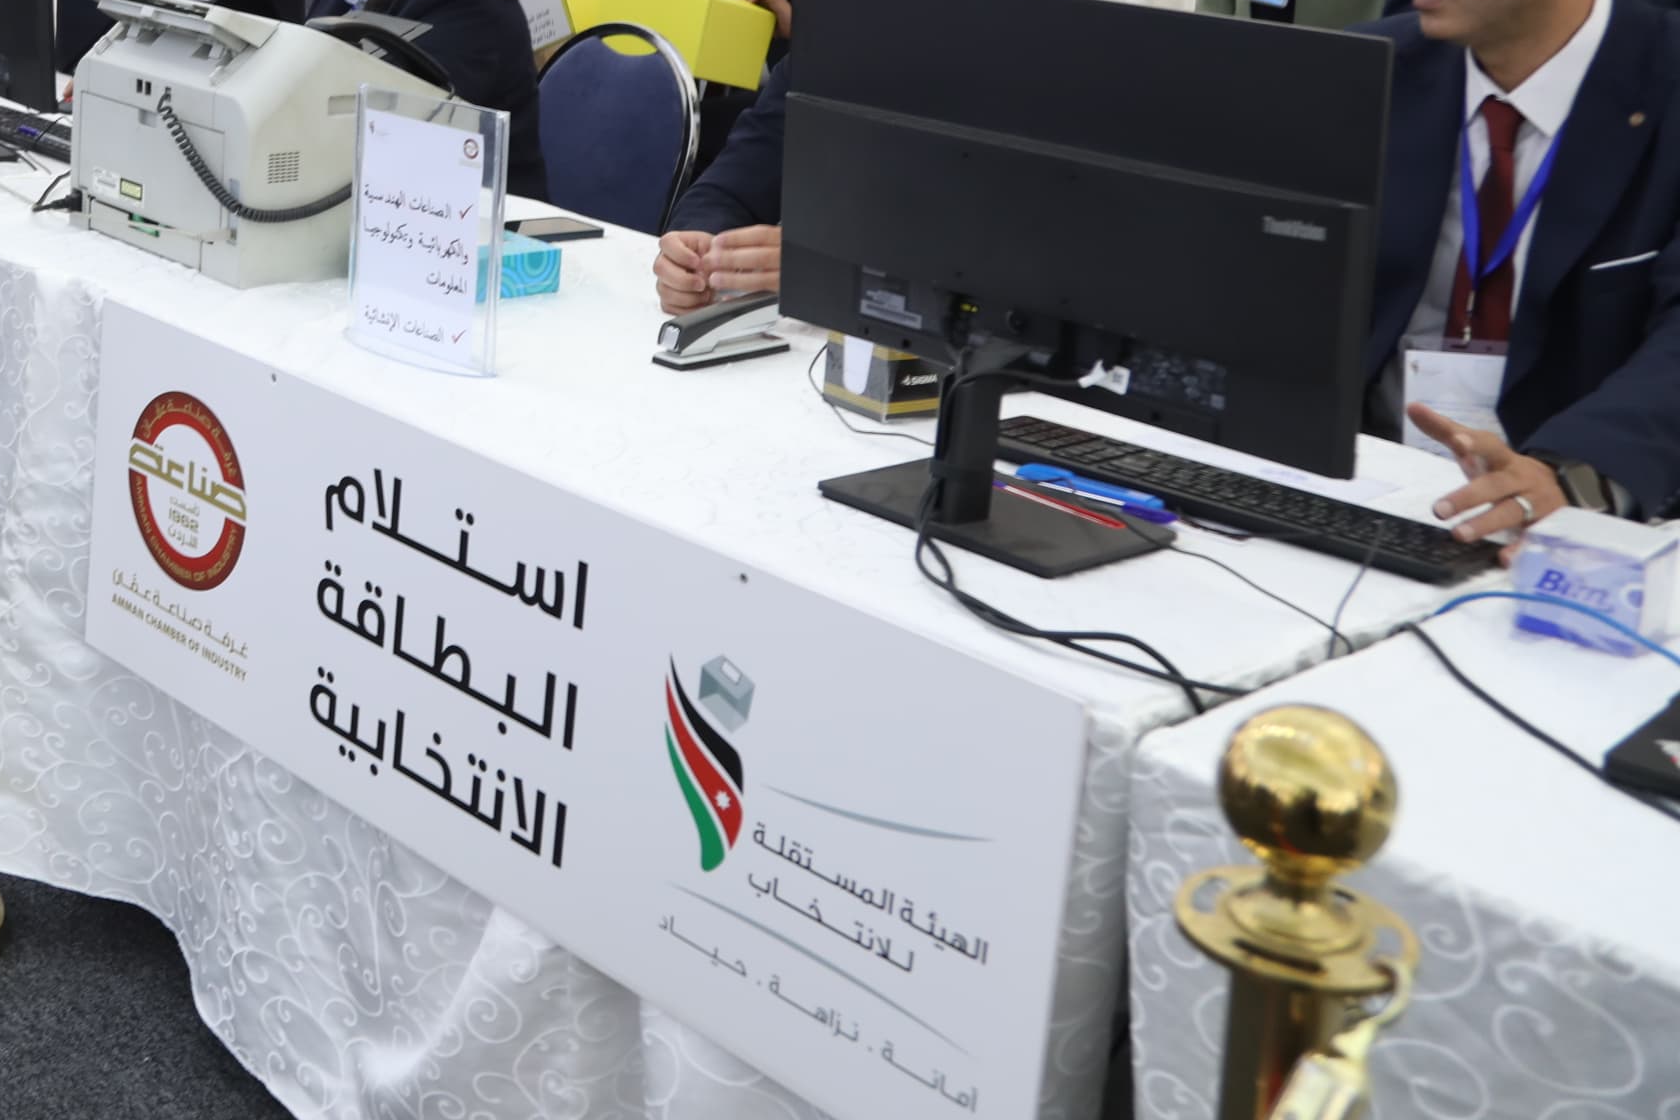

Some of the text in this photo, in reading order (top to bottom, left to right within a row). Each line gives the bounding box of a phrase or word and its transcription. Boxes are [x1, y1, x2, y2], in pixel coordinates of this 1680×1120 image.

[409, 196, 451, 219] الصناعات
[426, 270, 468, 295] المعلومات
[403, 320, 444, 344] الصناعات
[129, 444, 247, 522] صناعة
[325, 468, 588, 630] استلام
[111, 593, 247, 681] AMMAN CHAMBER OF INDUSTRY
[316, 560, 578, 751] البطاقة
[309, 666, 567, 869] الانتخابية
[748, 873, 914, 973] للانتخاب
[753, 821, 989, 965] الهيئة المستقلة
[659, 916, 747, 977] حياد
[769, 974, 859, 1042] نزاهة
